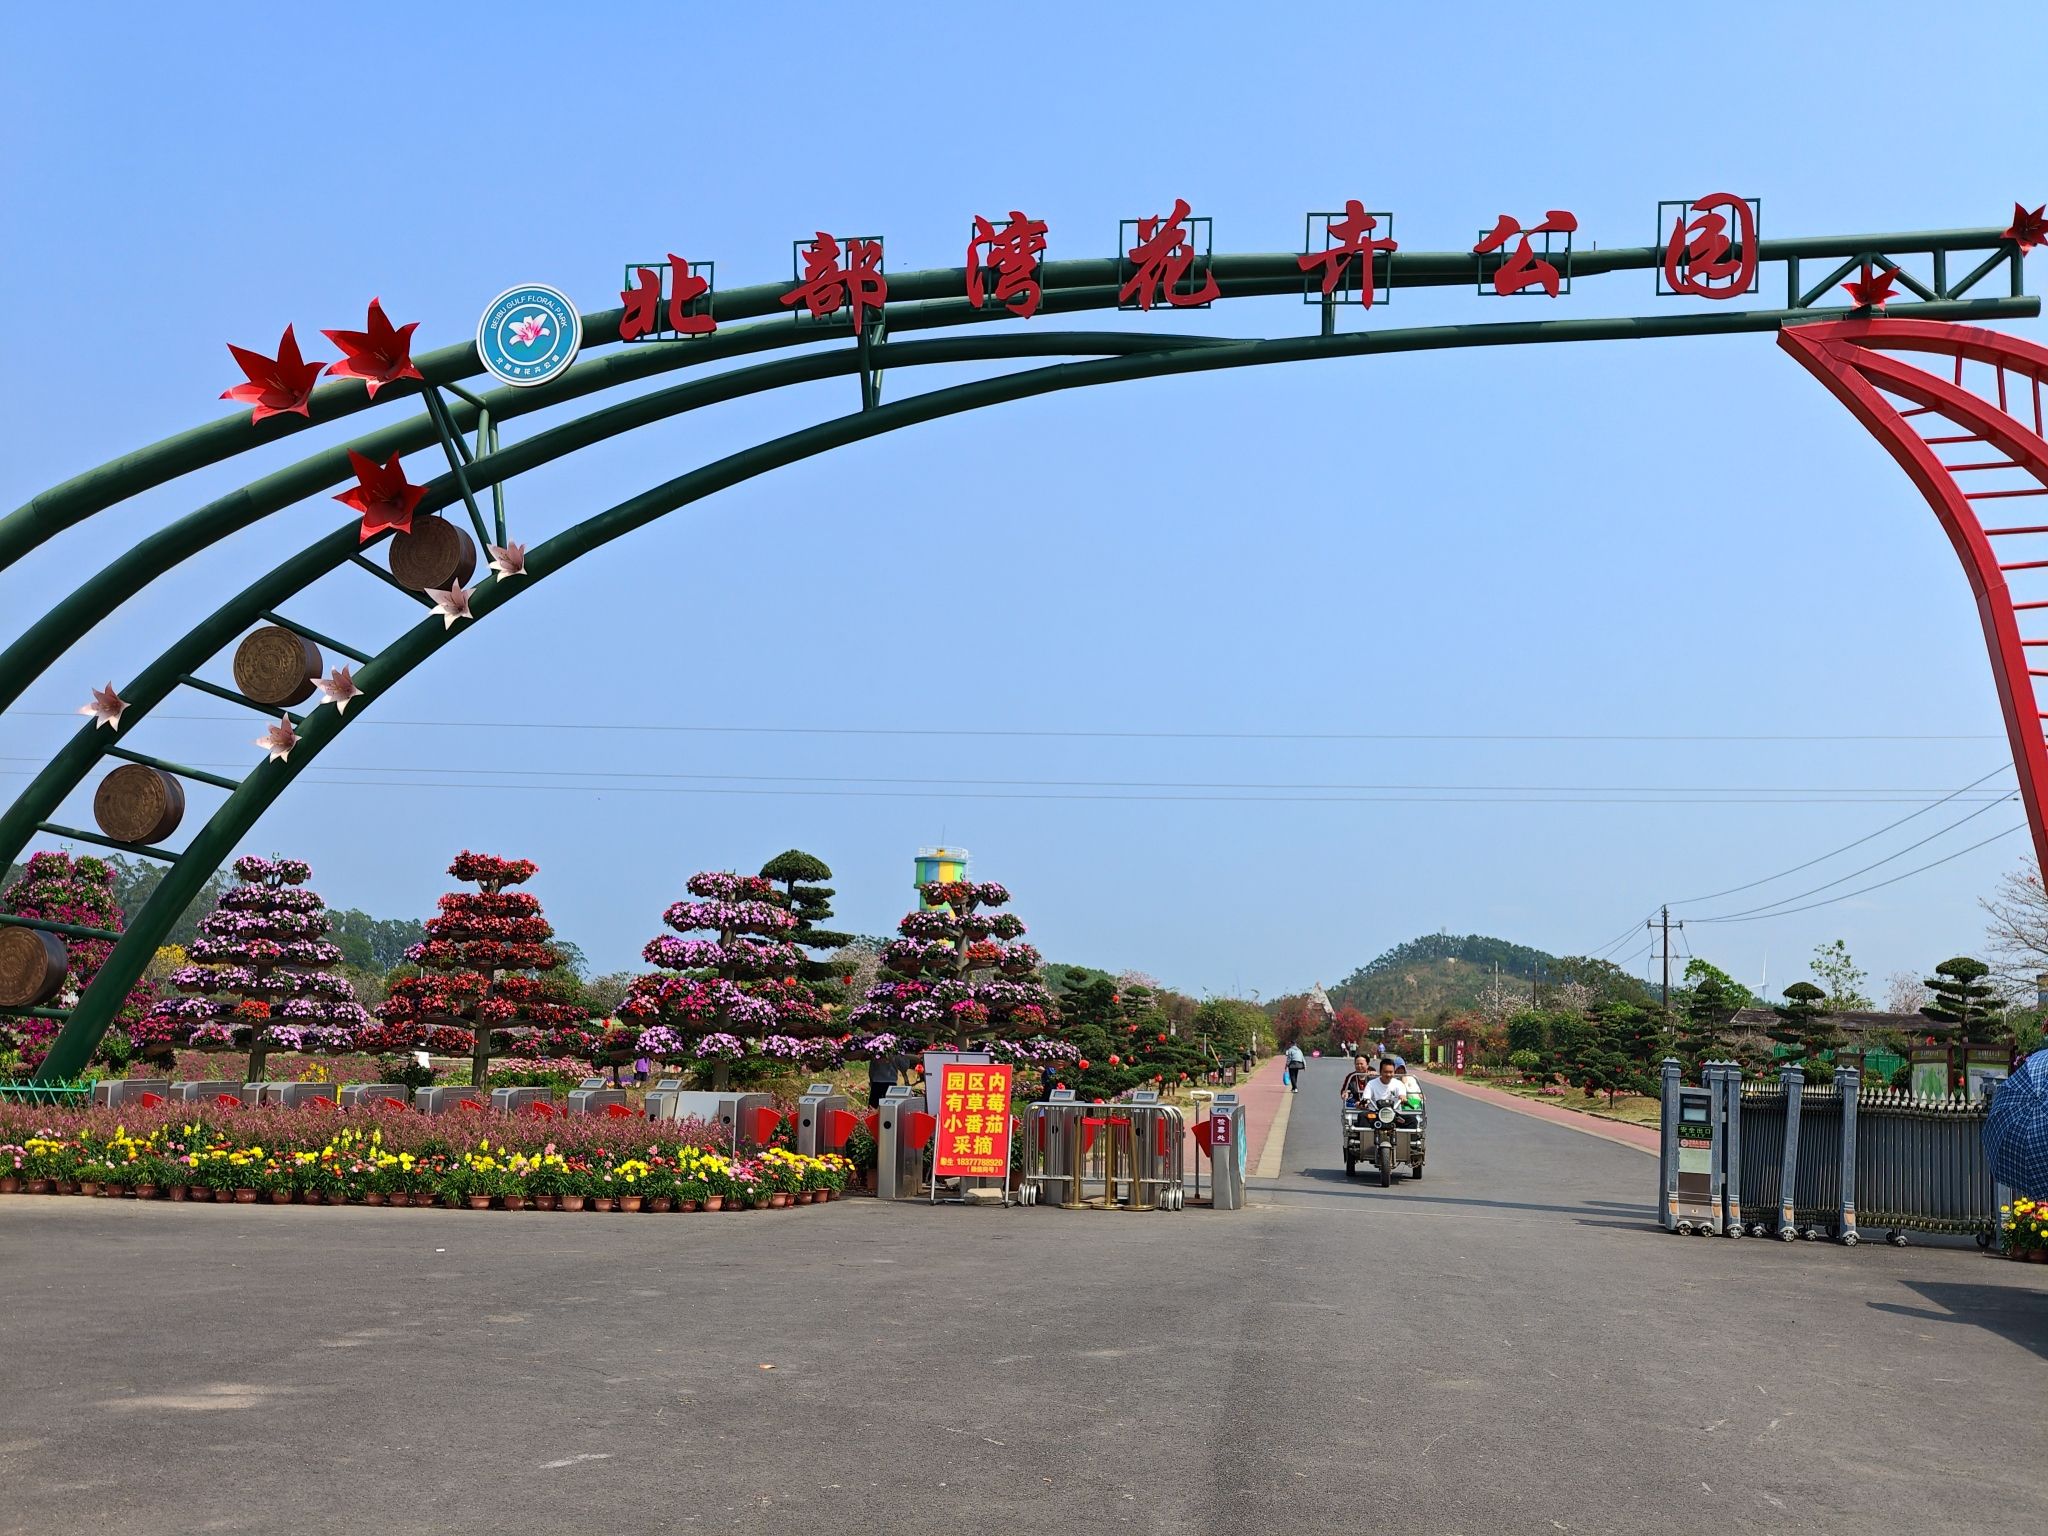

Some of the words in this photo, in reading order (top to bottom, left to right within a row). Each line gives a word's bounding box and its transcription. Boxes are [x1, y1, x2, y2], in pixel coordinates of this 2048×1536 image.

[619, 192, 1757, 340] 北部湾花卉公园
[490, 307, 507, 329] BEIBU
[506, 296, 526, 309] GULF
[527, 295, 556, 310] FLORAL
[554, 307, 568, 328] PARK
[947, 1072, 1006, 1091] 园区内
[945, 1093, 1005, 1113] 有草莓
[944, 1114, 1004, 1133] 小番茄
[952, 1135, 993, 1155] 采摘
